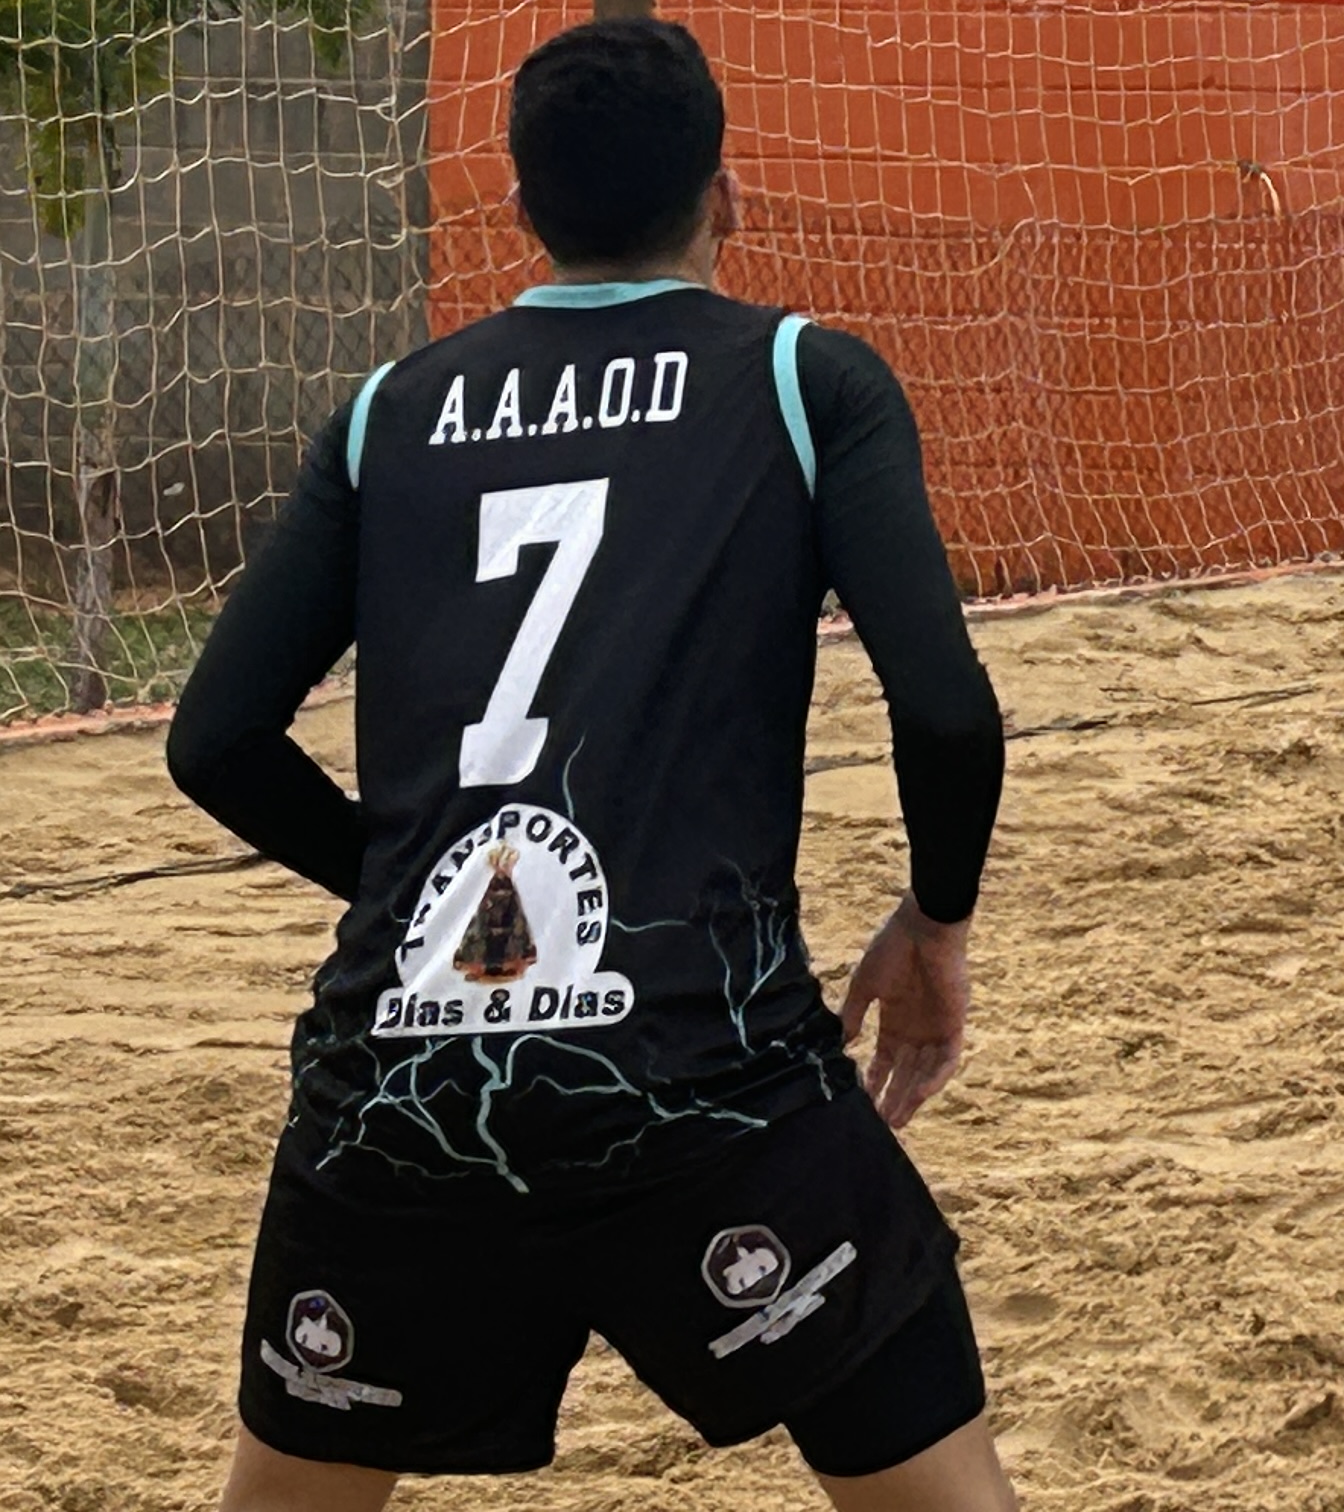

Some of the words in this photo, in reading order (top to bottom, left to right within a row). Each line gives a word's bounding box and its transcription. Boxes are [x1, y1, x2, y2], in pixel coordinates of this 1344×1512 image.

[428, 351, 688, 445] A.A.A.O.D
[459, 477, 608, 787] 7
[400, 811, 602, 962] TANPORTES
[484, 988, 511, 1024] &
